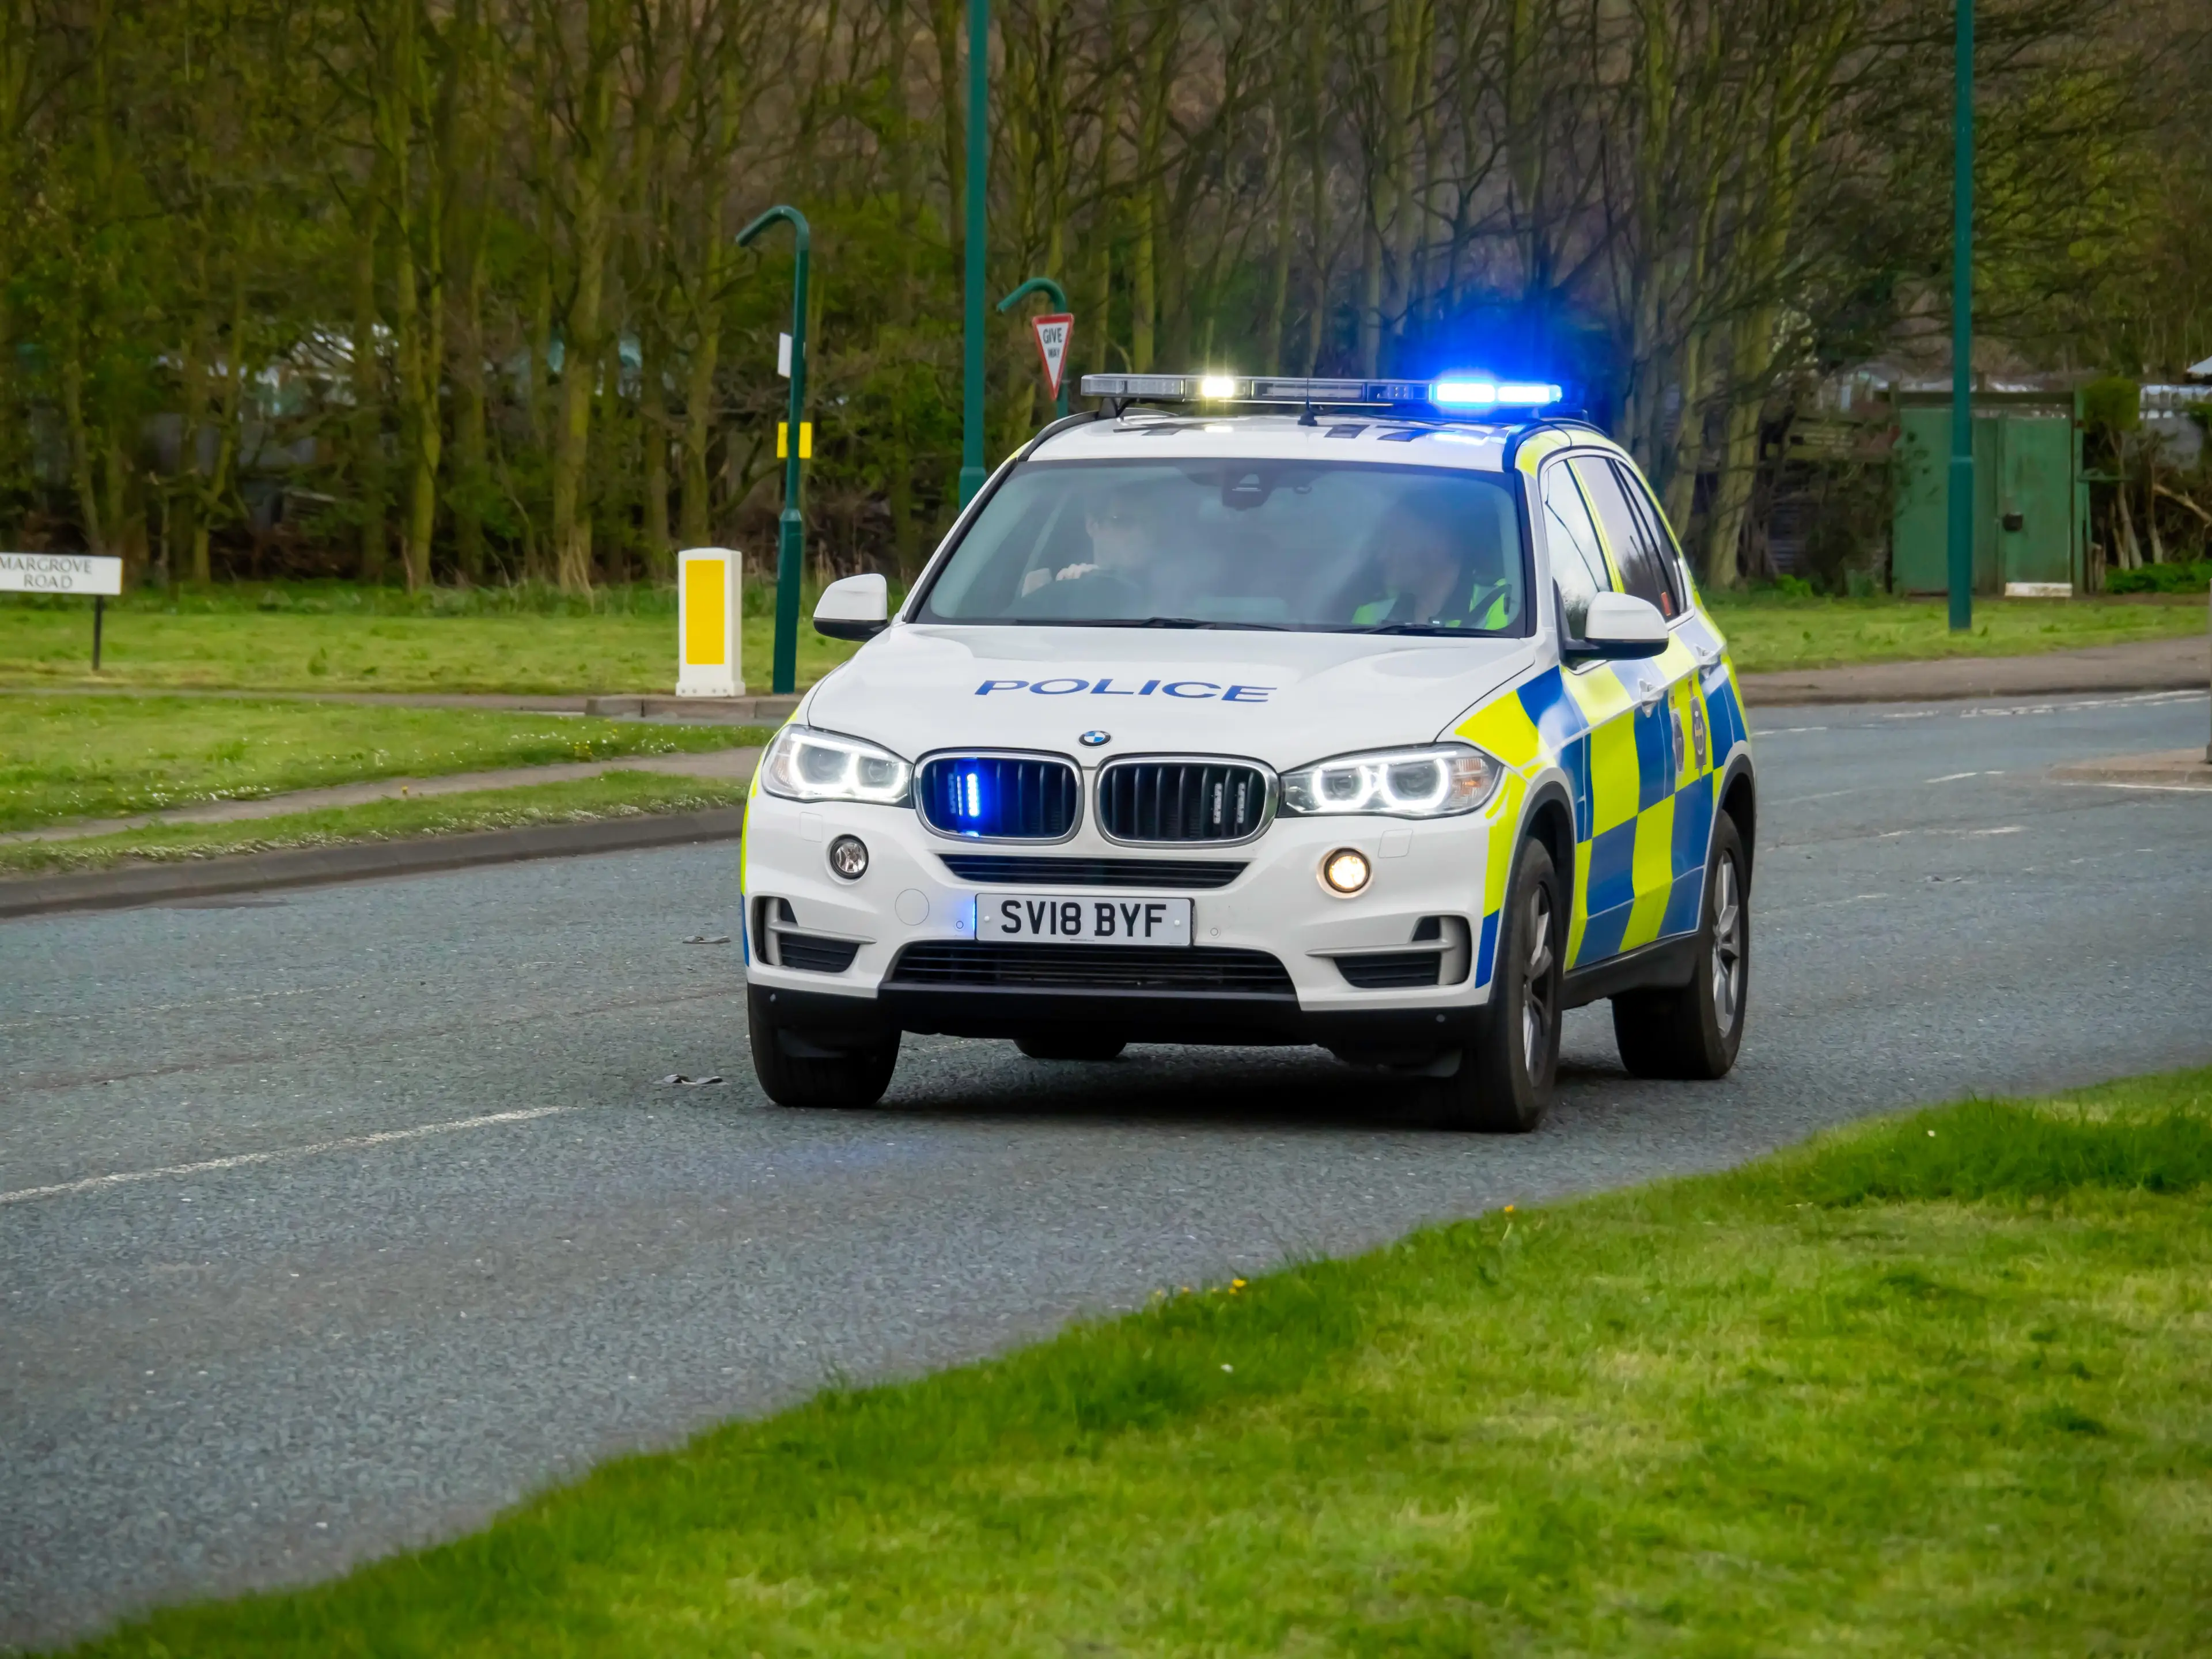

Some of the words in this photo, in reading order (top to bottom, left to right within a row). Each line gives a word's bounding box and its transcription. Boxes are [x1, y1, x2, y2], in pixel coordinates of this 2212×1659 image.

[1043, 328, 1062, 343] GIVE
[1048, 348, 1060, 358] WAY
[0, 555, 92, 574] MARGROVE
[24, 574, 73, 589] ROAD
[974, 679, 1277, 702] POLICE
[1001, 899, 1082, 935] SV18
[1094, 902, 1166, 937] BYF
